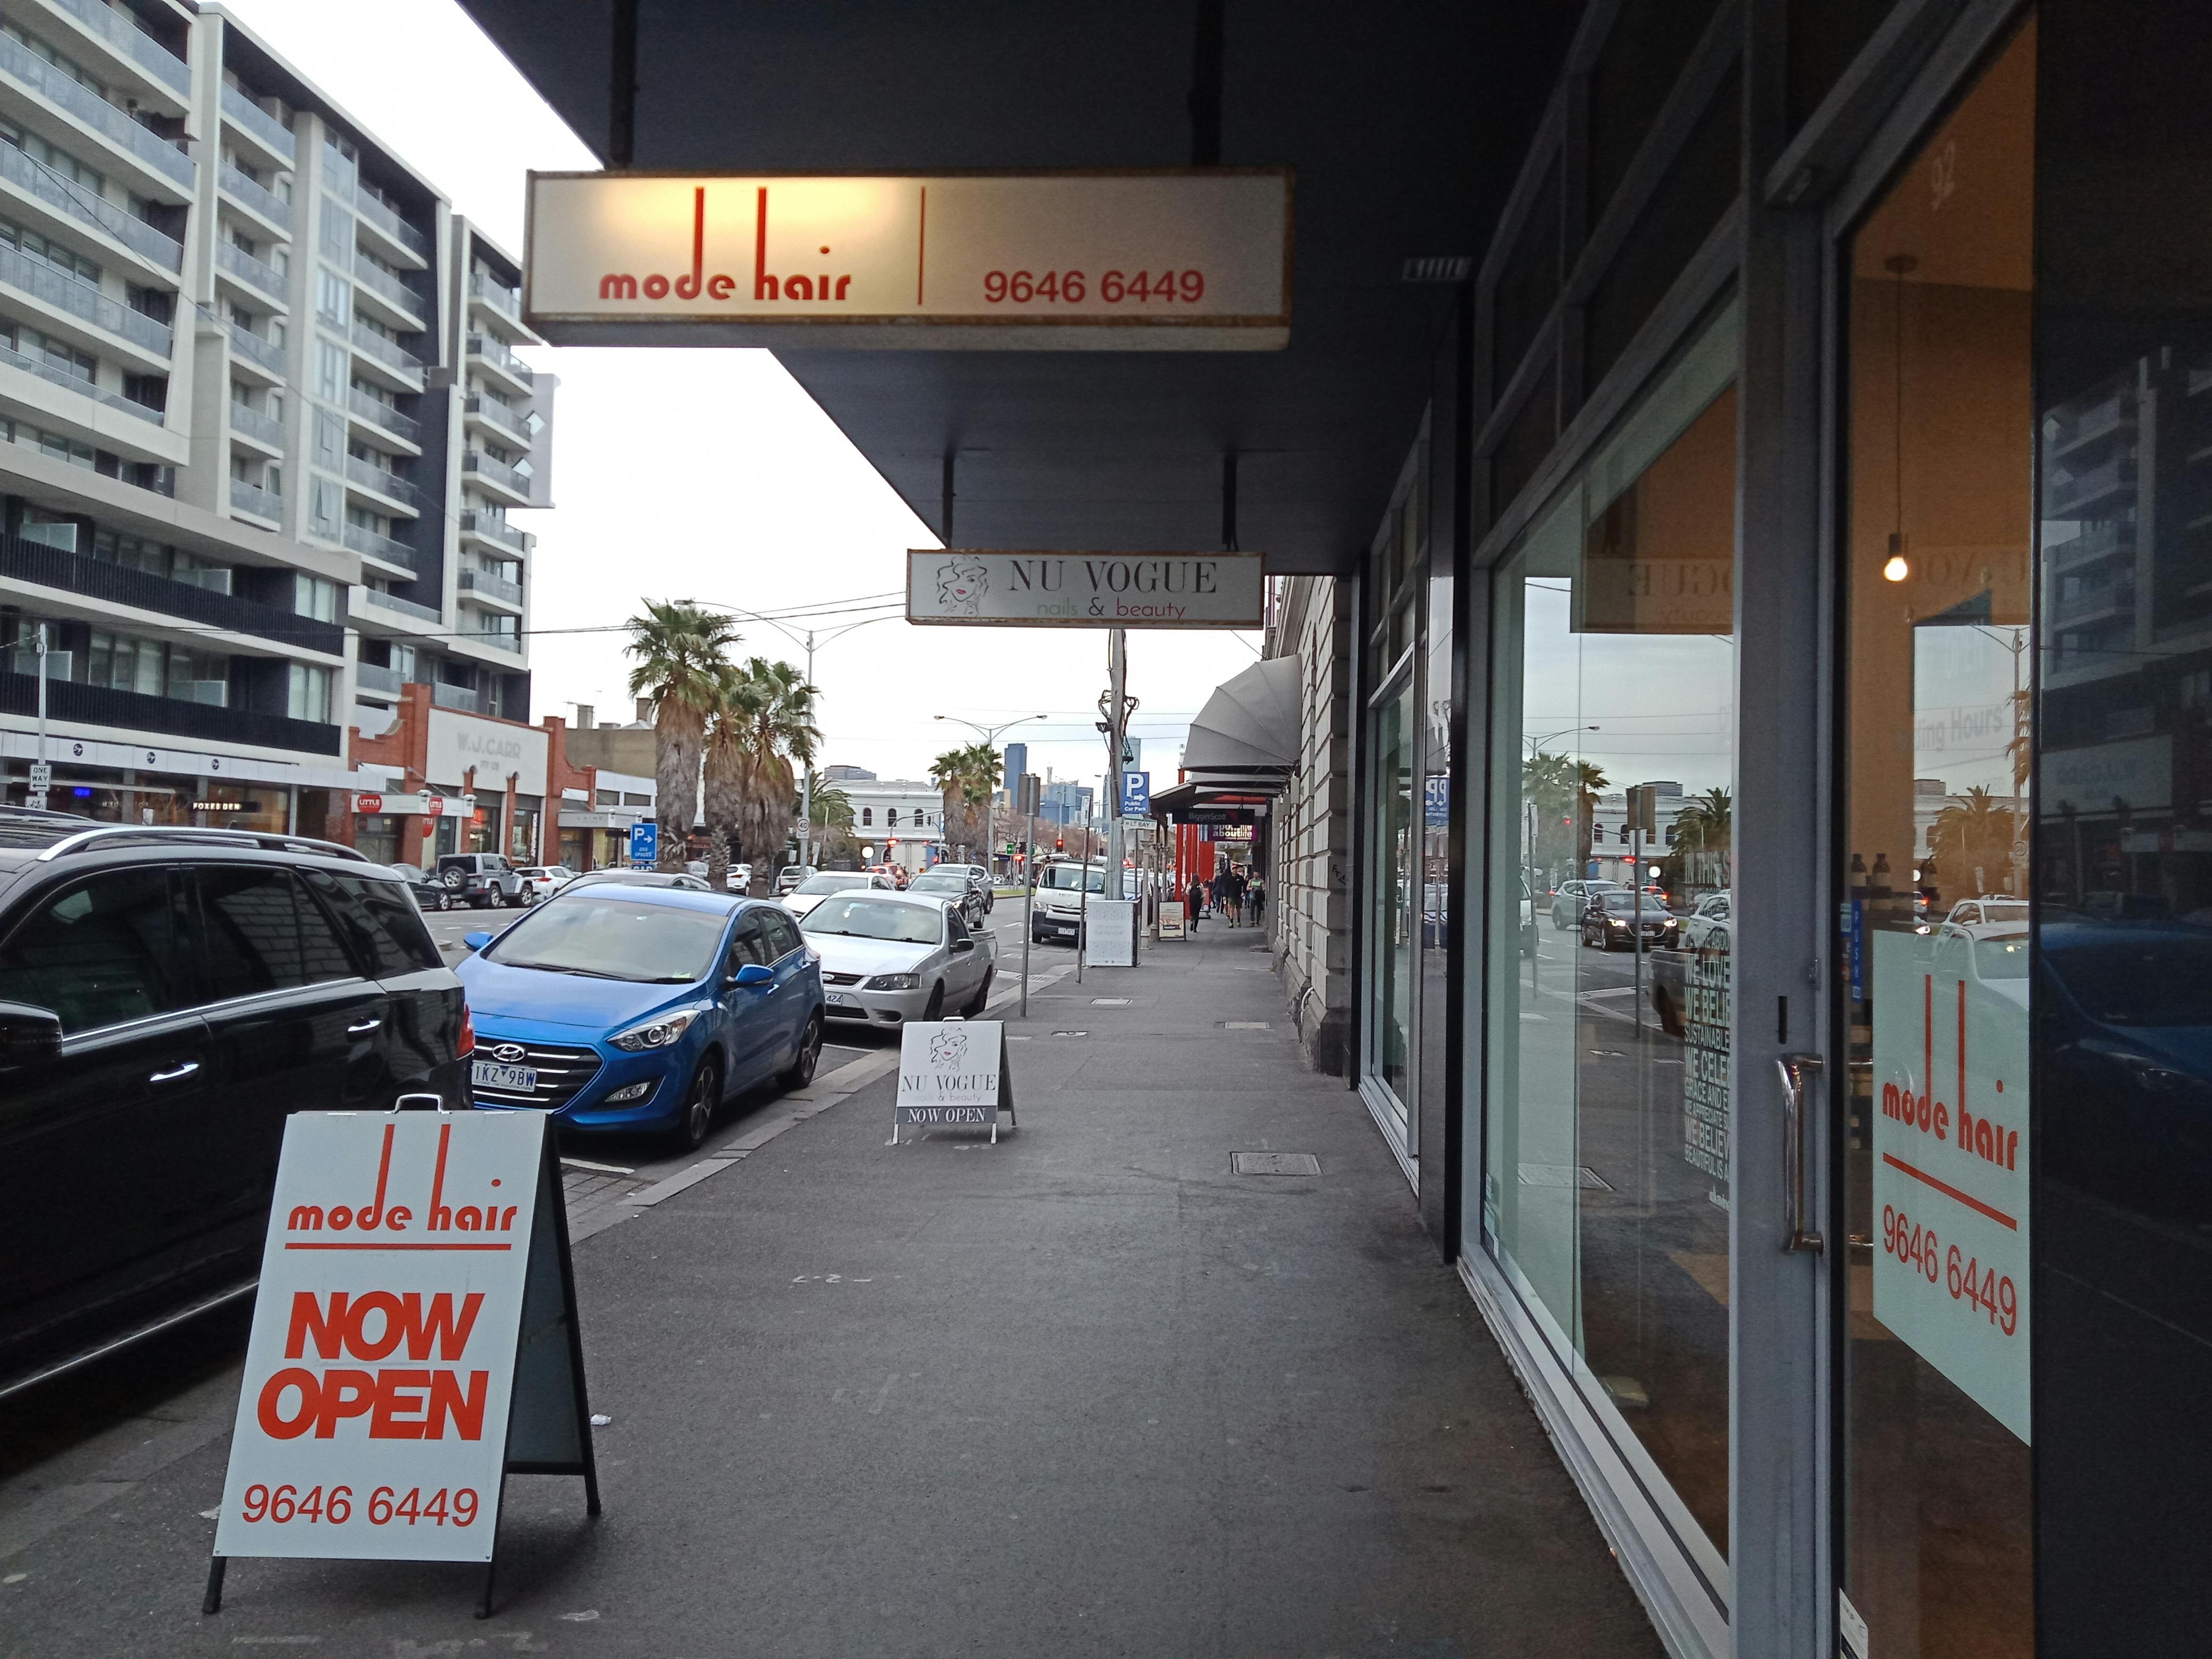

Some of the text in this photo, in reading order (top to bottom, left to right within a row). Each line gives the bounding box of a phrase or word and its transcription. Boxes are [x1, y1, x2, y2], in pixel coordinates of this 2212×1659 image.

[599, 186, 851, 300] mode hair
[983, 269, 1205, 303] 9646 6449
[1010, 560, 1217, 594] NU VOGUE
[1037, 597, 1186, 621] nails & beauty
[1703, 954, 1731, 990] LOVE
[1685, 986, 1730, 1027] WE BELIE
[1685, 1021, 1730, 1053] SUSTAINABLE
[509, 1070, 535, 1087] 9BW
[901, 1074, 996, 1092] NU VOGUE
[1685, 1045, 1730, 1089] WE CELE
[1882, 974, 2017, 1171] mode hair
[950, 1093, 982, 1102] beauty
[1685, 1077, 1707, 1103] GRACE
[1708, 1085, 1722, 1109] AND
[907, 1108, 986, 1123] NOW OPEN
[1685, 1115, 1729, 1160] WE BELIEV
[287, 1124, 518, 1231] mode hair
[1883, 1204, 2017, 1336] 9646 6449
[284, 1291, 485, 1361] NOW
[257, 1367, 490, 1440] OPEN
[242, 1484, 479, 1527] 9646 6449
